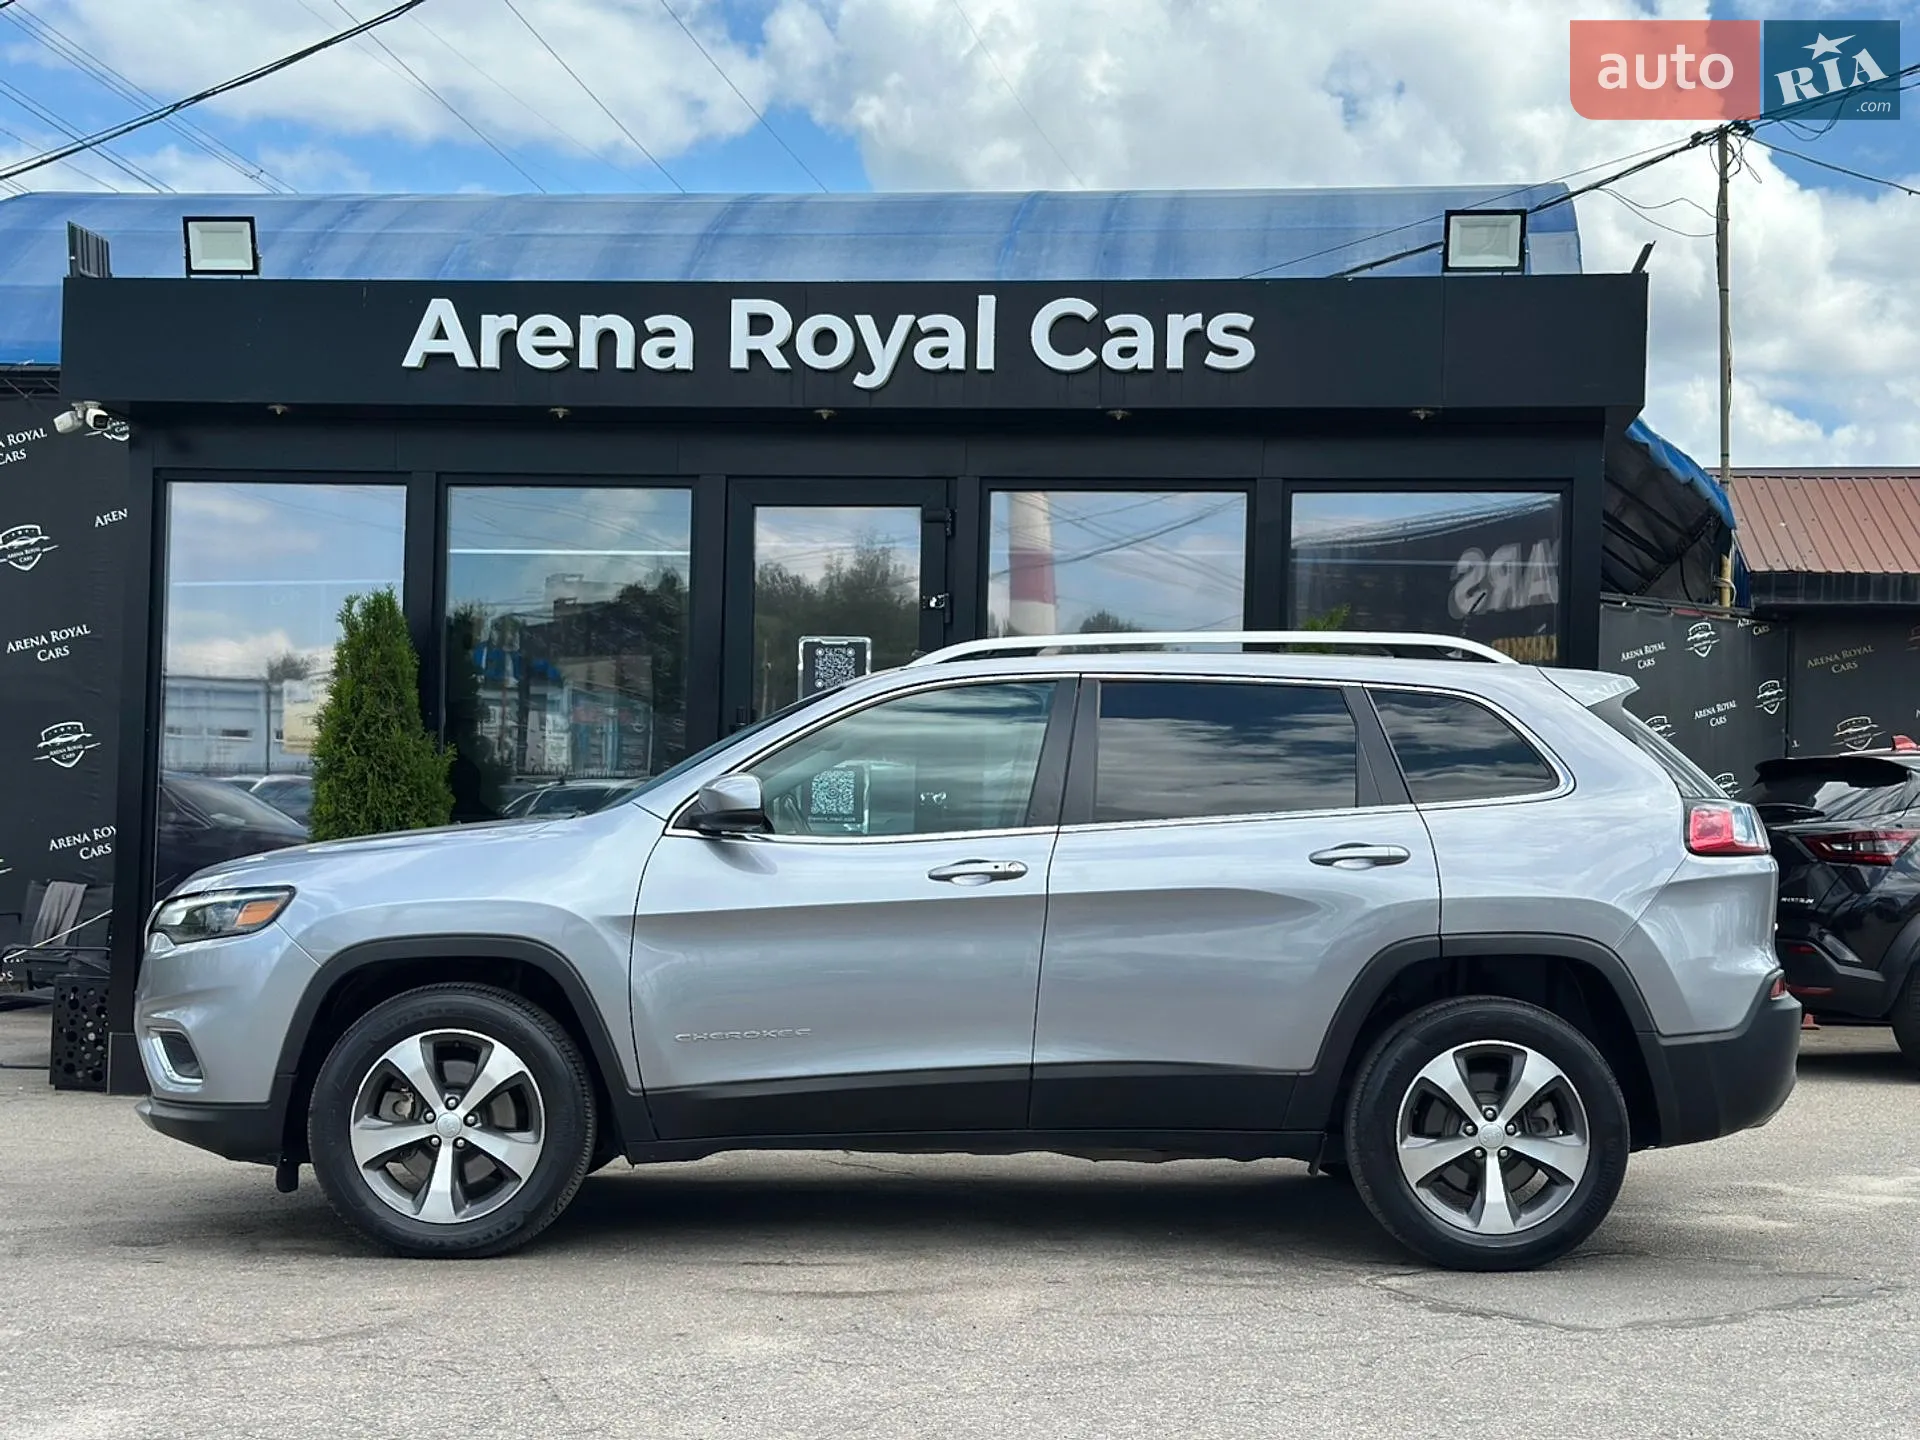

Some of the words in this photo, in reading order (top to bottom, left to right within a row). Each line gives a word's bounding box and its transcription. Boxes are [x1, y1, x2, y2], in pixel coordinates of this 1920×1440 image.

[401, 298, 694, 371] Arena
[729, 295, 997, 391] Royal
[1031, 298, 1257, 373] Cars
[7, 428, 48, 446] ROYAL
[7, 635, 49, 654] ARENA
[50, 624, 91, 643] ROYAL
[37, 645, 70, 661] CARS
[1620, 649, 1645, 662] ARENA
[1644, 641, 1667, 654] ROYAL
[1807, 653, 1840, 669] ARENA
[1841, 645, 1875, 660] ROYAL
[1637, 657, 1656, 670] CARS
[1831, 661, 1859, 674] CARS
[1694, 708, 1717, 720] ARENA
[1716, 699, 1737, 713] ROYAL
[1709, 715, 1728, 727] CARS
[49, 832, 92, 852] ARENA
[79, 843, 112, 860] CARS
[674, 1027, 812, 1042] CHEROKEE
